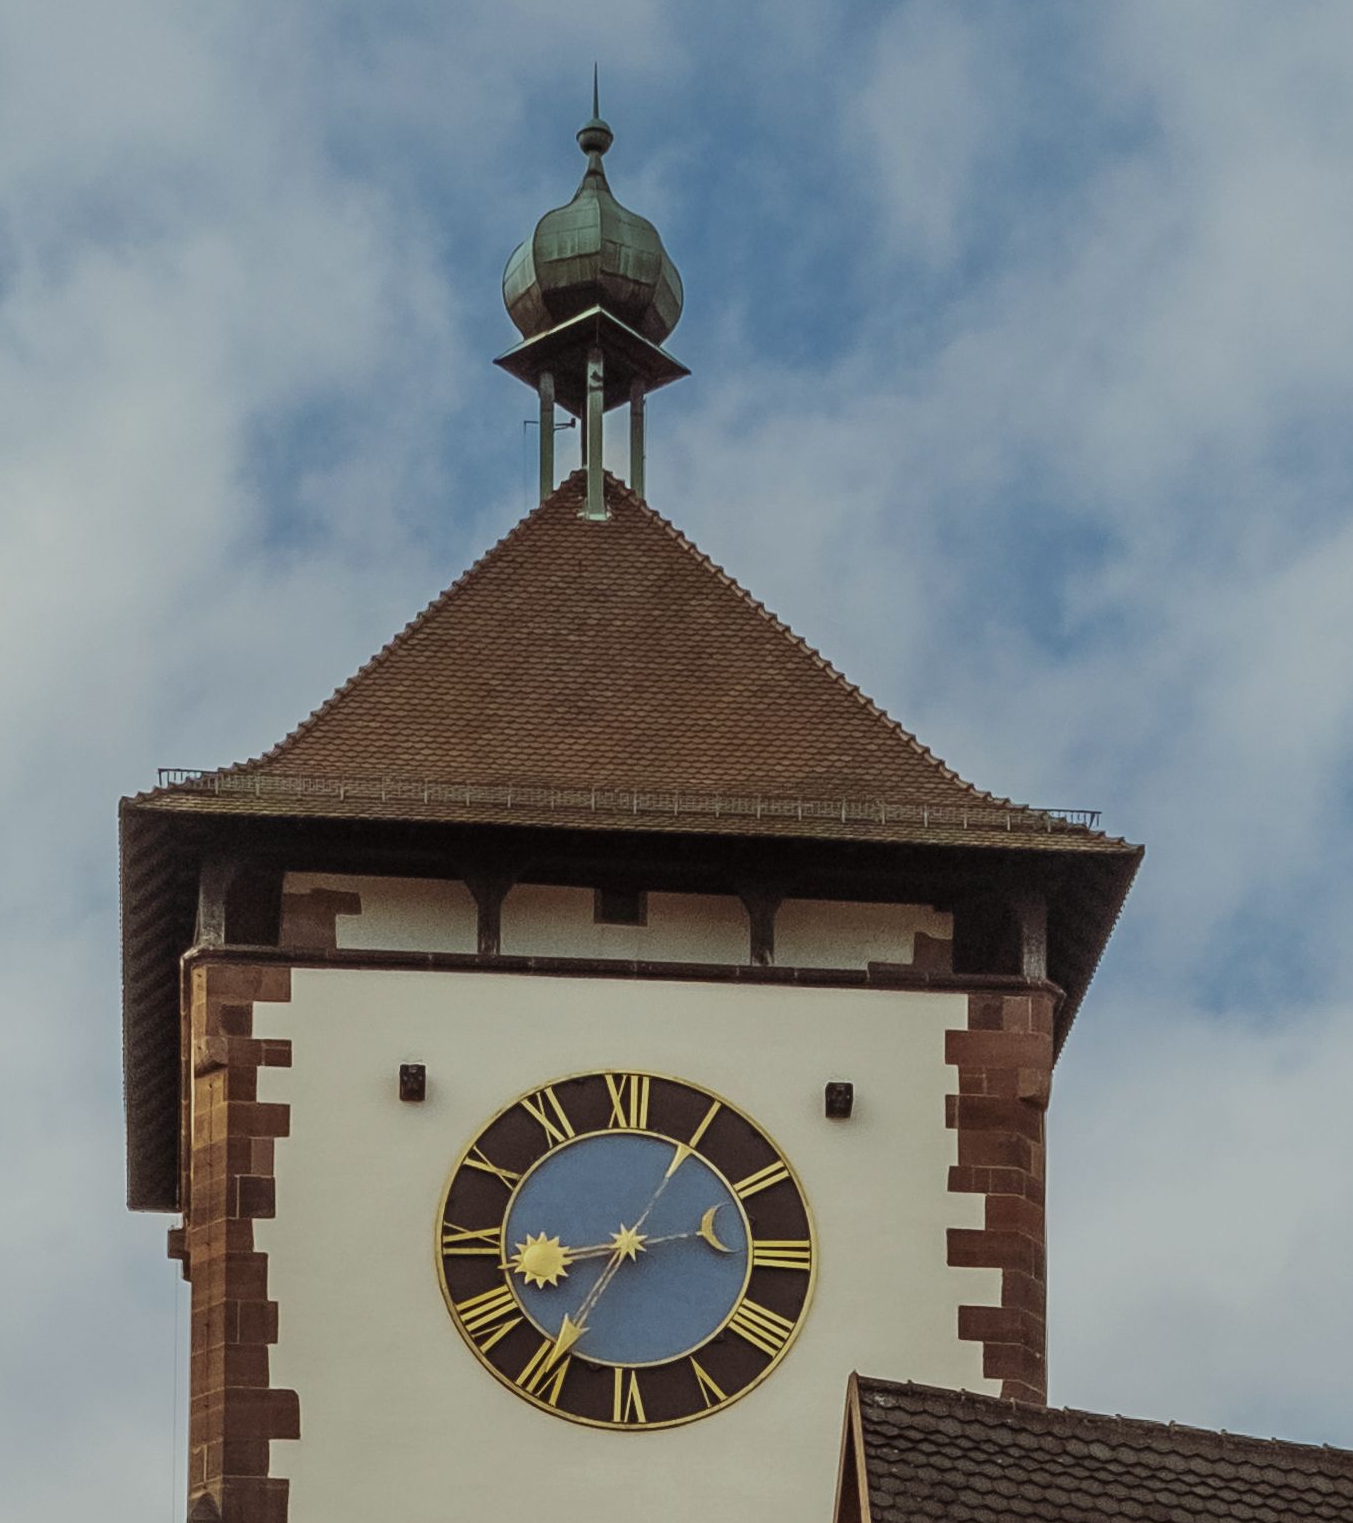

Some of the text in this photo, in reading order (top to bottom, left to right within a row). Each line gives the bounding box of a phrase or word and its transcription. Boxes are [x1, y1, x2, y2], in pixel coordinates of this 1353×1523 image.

[520, 1085, 576, 1149] XI
[604, 1074, 652, 1129] XII
[463, 1144, 523, 1192] X
[733, 1159, 791, 1200] II
[752, 1239, 811, 1271] III
